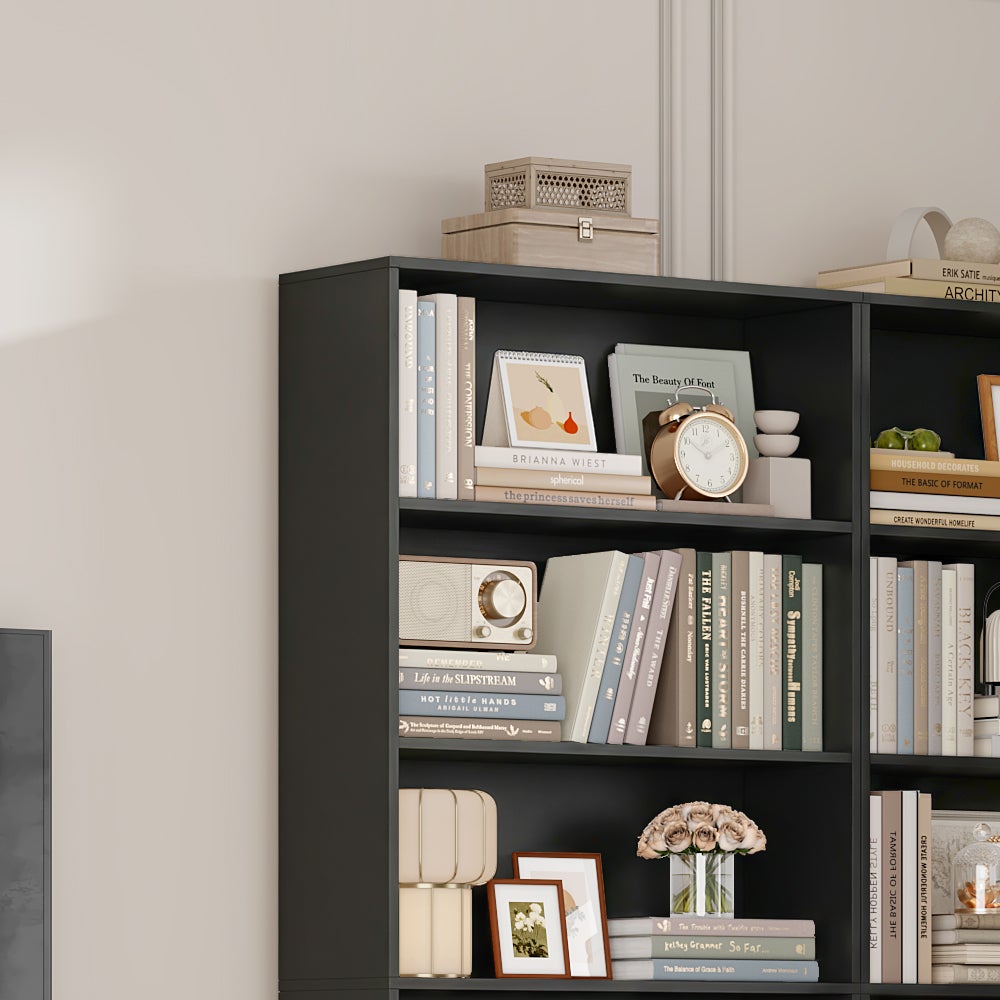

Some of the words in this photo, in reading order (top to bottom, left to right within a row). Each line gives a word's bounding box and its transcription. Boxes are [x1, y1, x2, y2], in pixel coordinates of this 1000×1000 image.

[942, 267, 958, 278] ERIK
[961, 269, 980, 280] SATIE
[632, 374, 650, 384] The
[652, 375, 682, 388] Beauty
[683, 376, 696, 387] Of
[697, 378, 716, 389] Font
[702, 424, 710, 433] 12
[512, 454, 568, 467] BRIANNA
[572, 457, 607, 469] WIEST
[891, 459, 936, 470] HOUSEHOLD
[937, 462, 979, 473] DECORATES
[550, 474, 584, 486] spherical
[902, 477, 917, 486] THE
[918, 478, 939, 487] BASIC
[940, 479, 951, 488] OF
[953, 480, 983, 490] FORMAT
[893, 515, 914, 525] CREATE
[915, 516, 947, 526] WONDERFUL
[948, 518, 975, 528] HOMELIFE
[701, 569, 712, 594] THE
[885, 572, 894, 633] UNBOUND
[701, 596, 712, 641] FALLEN
[786, 610, 801, 659] Sympathy
[958, 607, 972, 669] BLACK
[414, 672, 431, 684] Life
[431, 673, 440, 683] in
[441, 673, 454, 684] the
[454, 674, 517, 687] SLIPSTREAM
[421, 695, 440, 703] HOT
[444, 695, 477, 705] little
[786, 681, 801, 723] Humans
[958, 678, 972, 719] KEY
[437, 704, 469, 712] ABIGAIL
[473, 705, 499, 713] ULMAN
[729, 940, 741, 953] So
